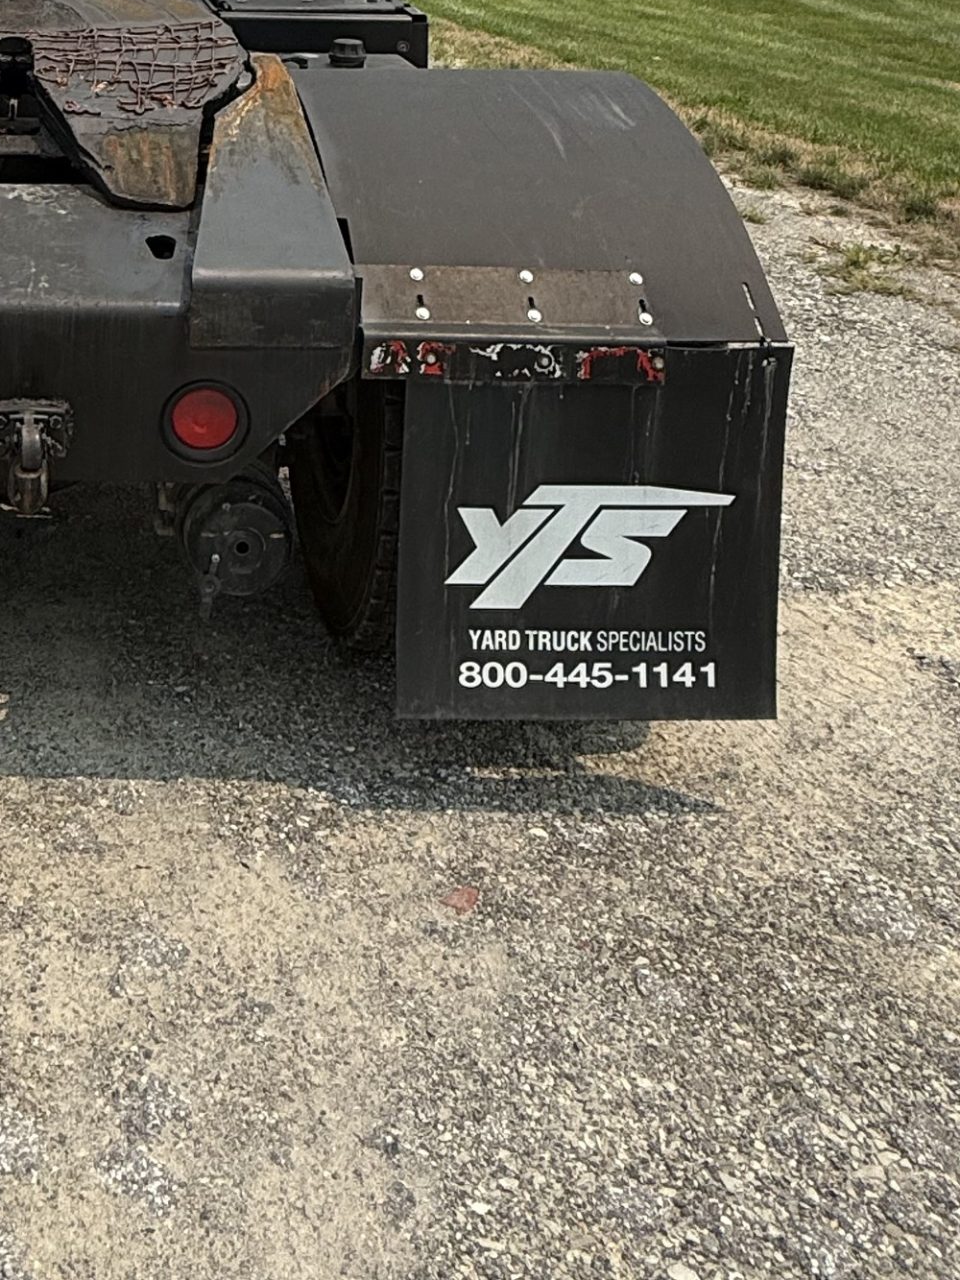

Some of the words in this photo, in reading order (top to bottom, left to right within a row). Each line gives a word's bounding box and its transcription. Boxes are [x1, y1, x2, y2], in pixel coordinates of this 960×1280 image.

[444, 484, 736, 609] YTS
[468, 629, 520, 651] YARD
[525, 629, 592, 651] TRUCK
[596, 631, 707, 652] SPECIALISTS
[458, 661, 717, 689] 800-445-1141
